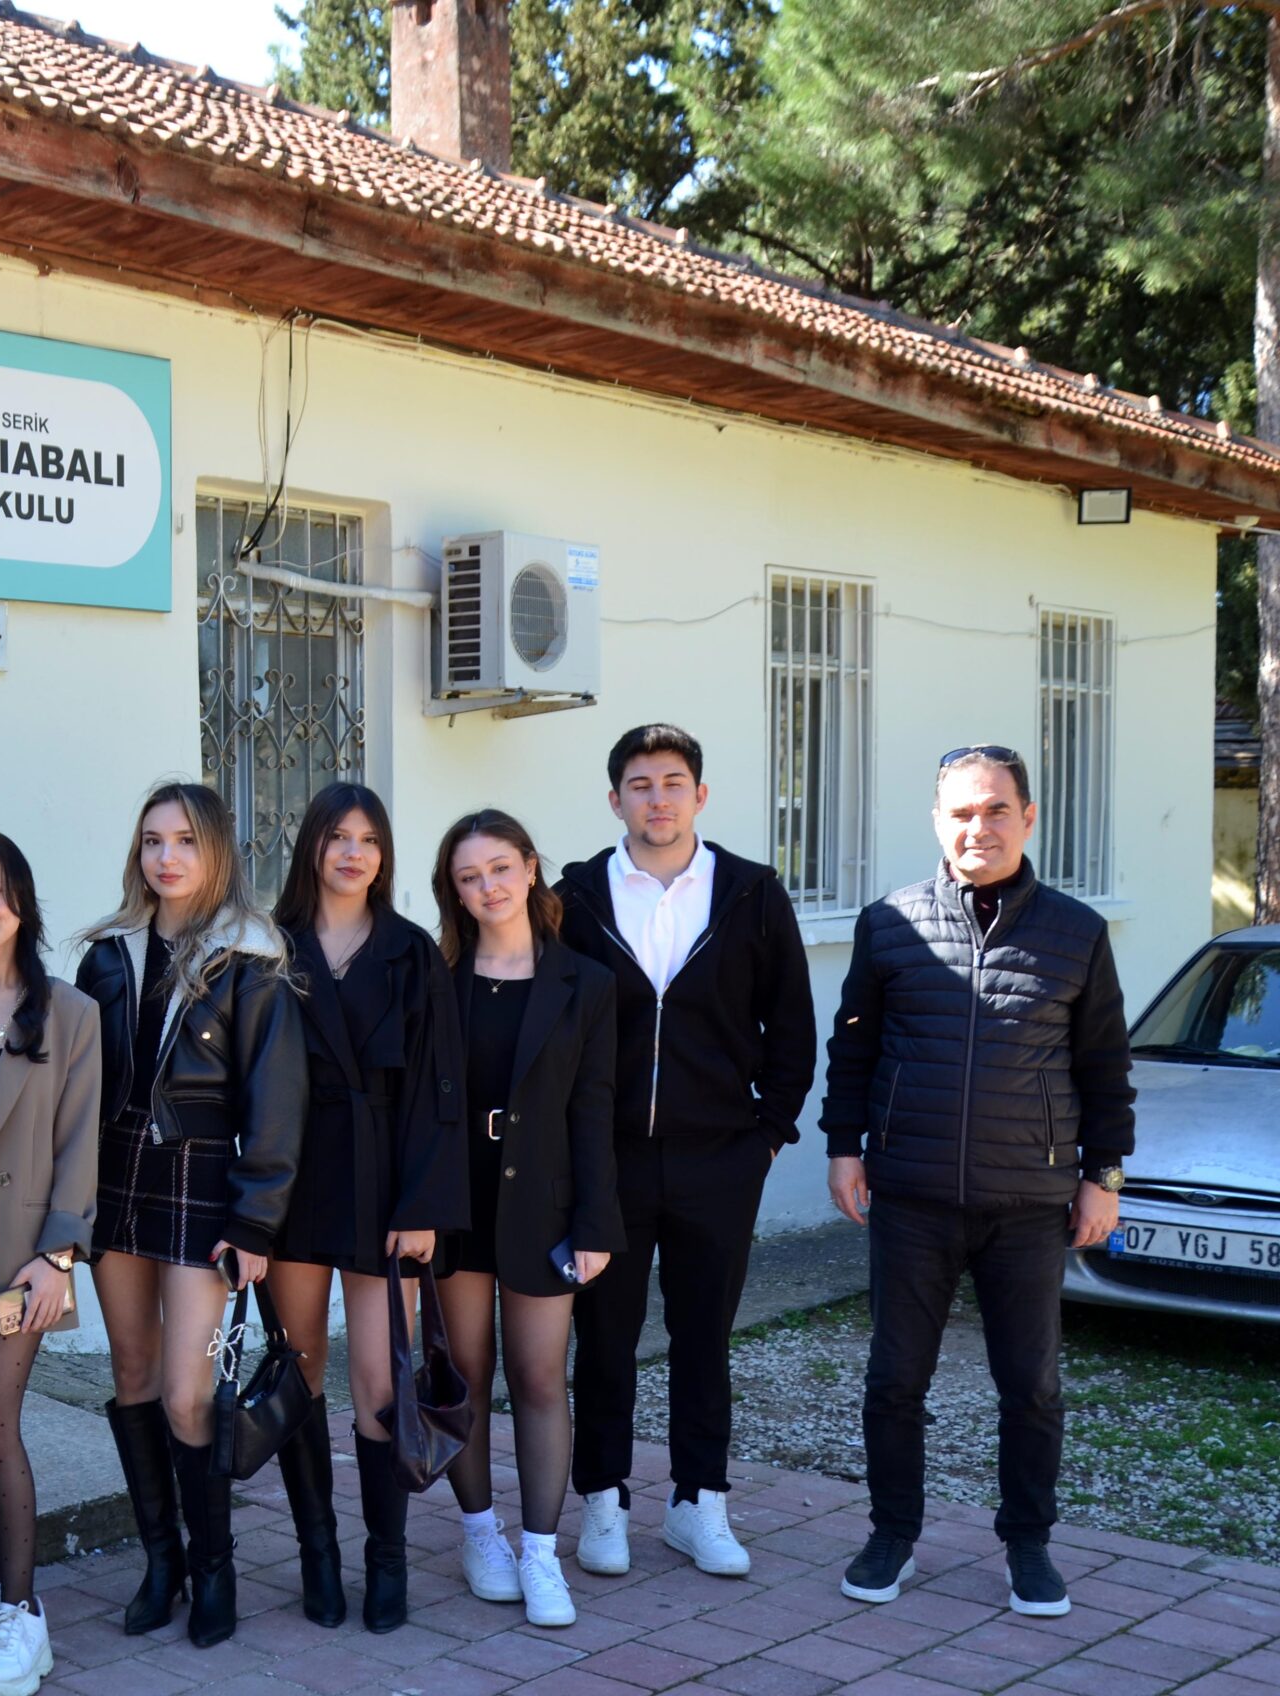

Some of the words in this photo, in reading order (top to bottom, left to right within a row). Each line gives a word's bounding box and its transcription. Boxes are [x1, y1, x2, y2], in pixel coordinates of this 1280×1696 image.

[2, 412, 49, 434] SERİK
[1113, 1237, 1124, 1246] TR
[1126, 1226, 1157, 1251] 07
[1178, 1231, 1227, 1260] YGJ
[1249, 1239, 1280, 1267] 58
